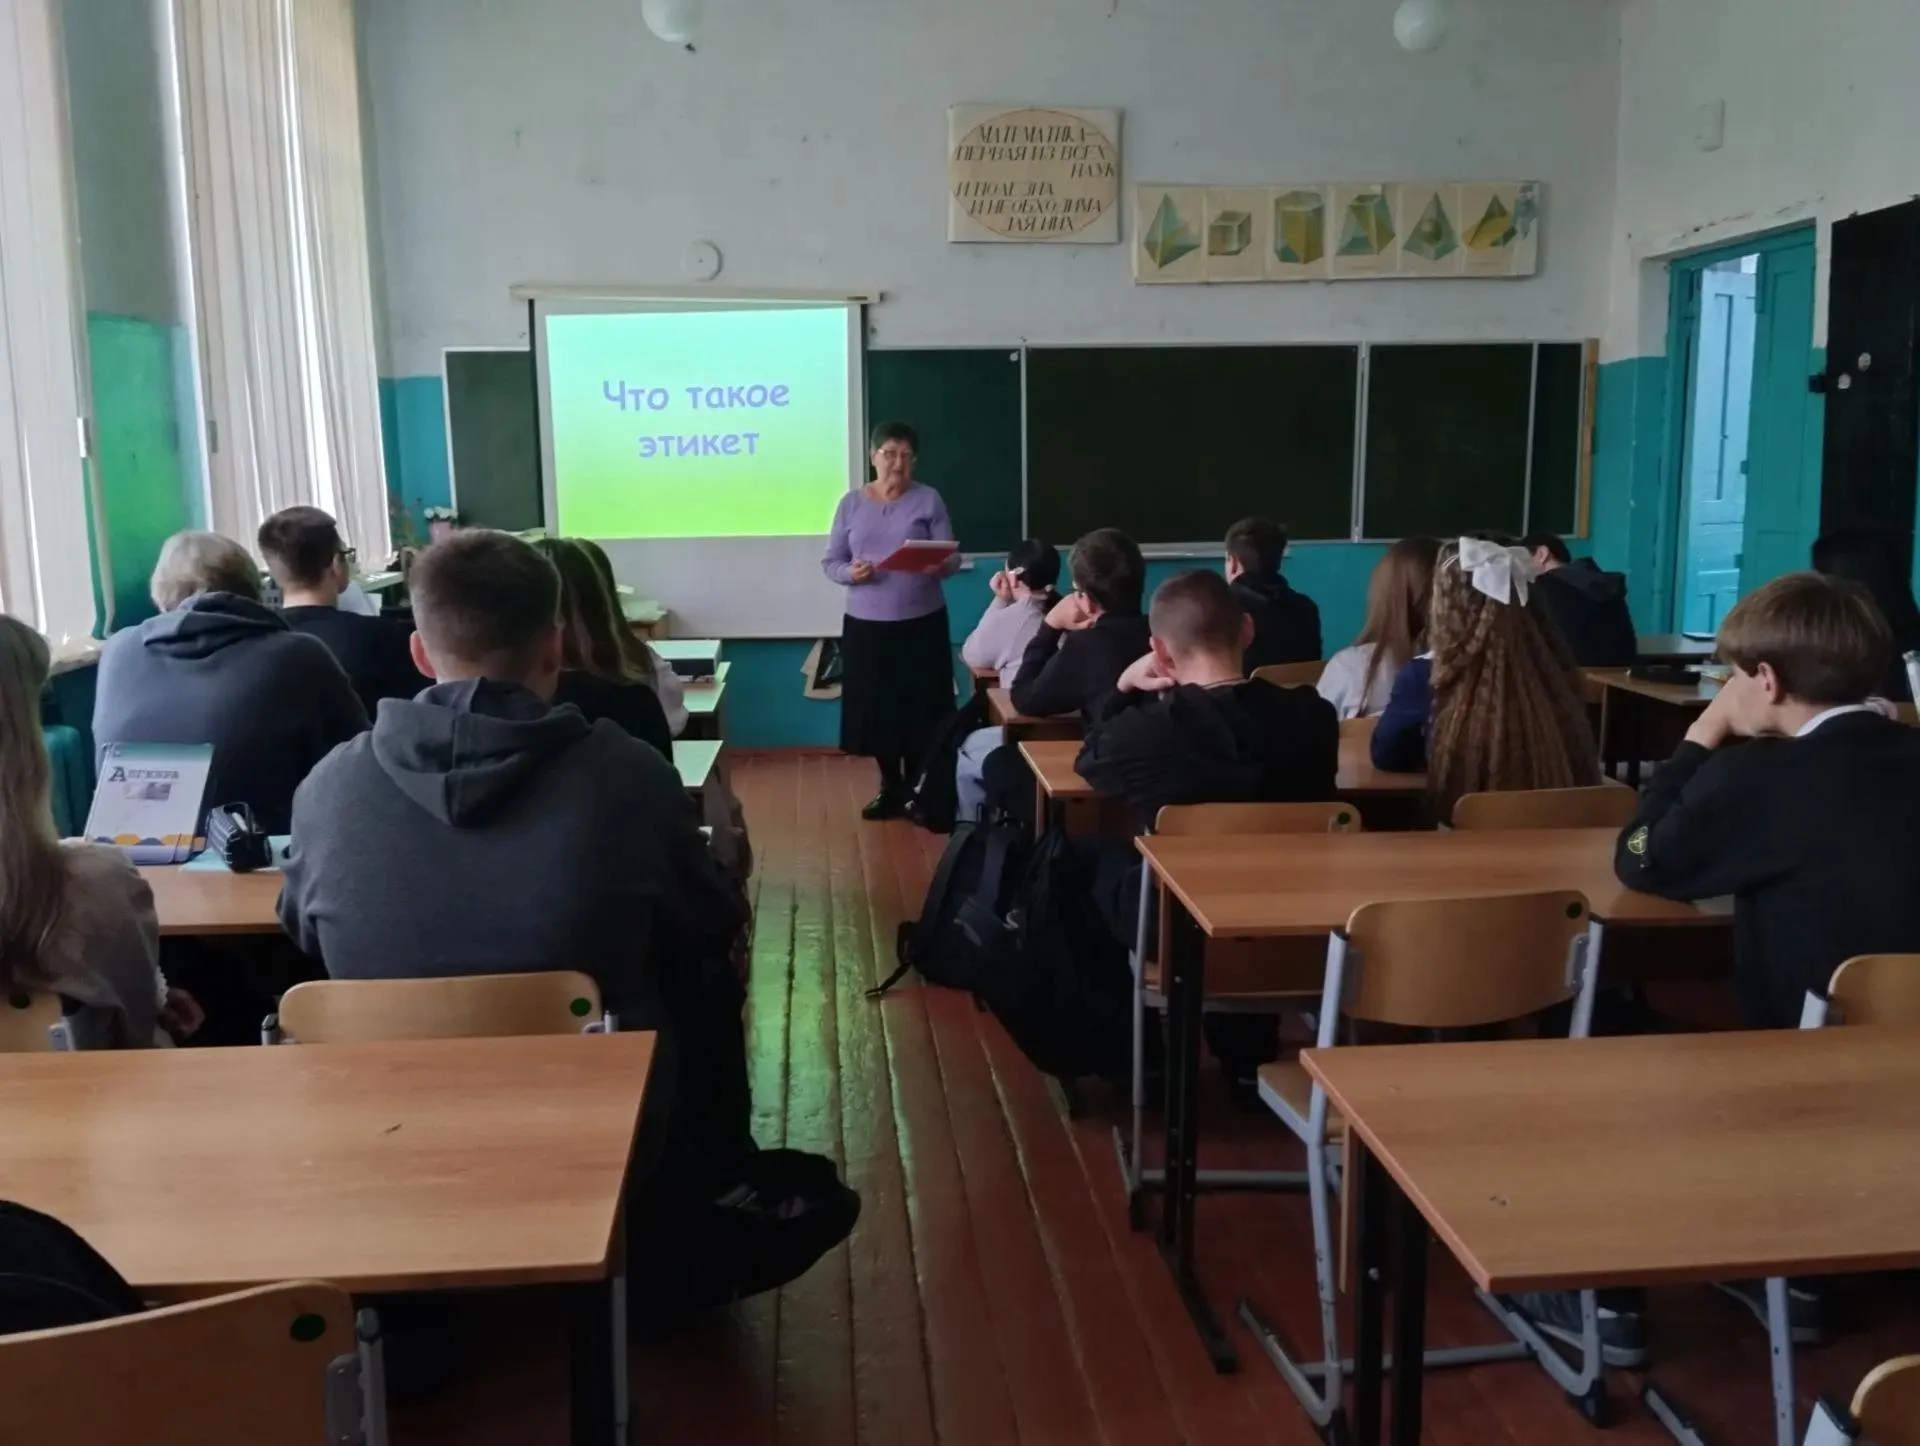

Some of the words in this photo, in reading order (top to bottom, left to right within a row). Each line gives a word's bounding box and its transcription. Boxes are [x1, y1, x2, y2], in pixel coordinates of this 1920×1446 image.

[602, 380, 670, 411] Что
[685, 383, 790, 409] такое
[638, 432, 760, 458] этикет
